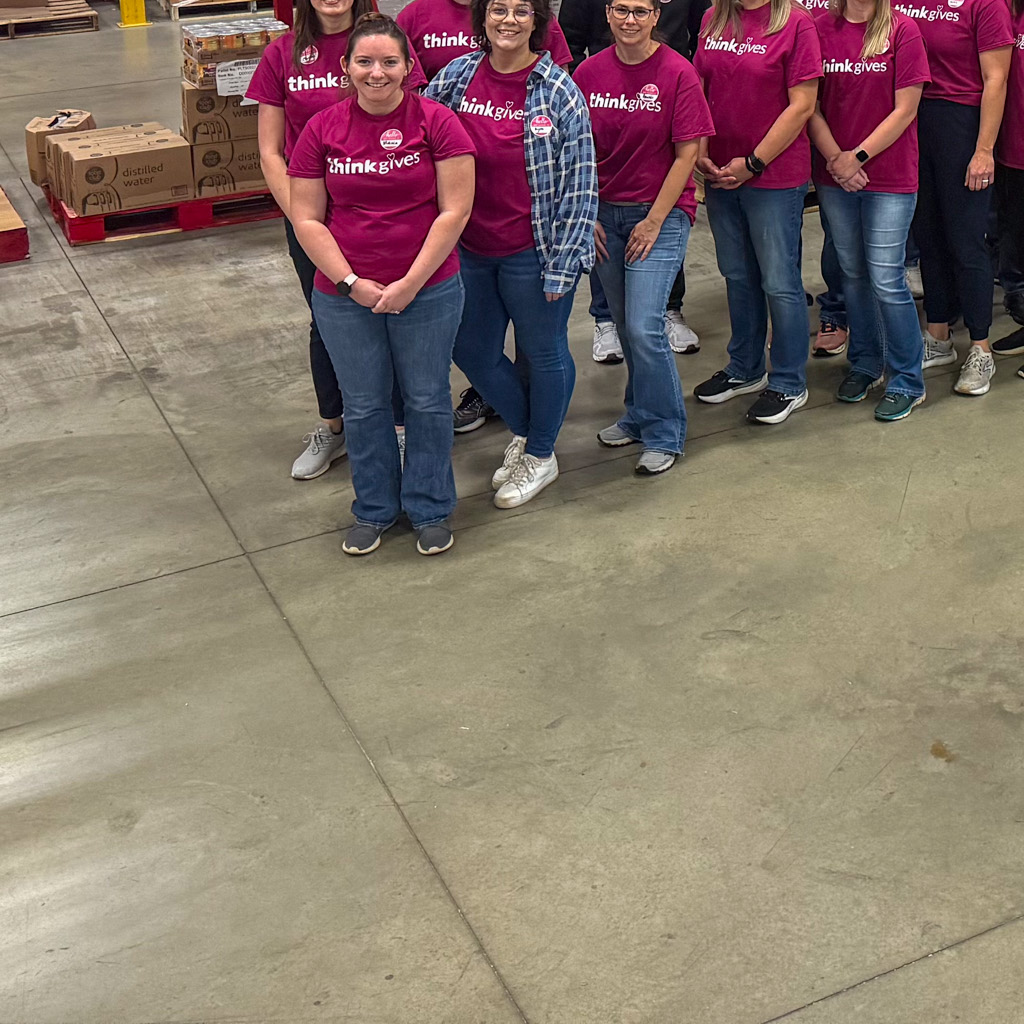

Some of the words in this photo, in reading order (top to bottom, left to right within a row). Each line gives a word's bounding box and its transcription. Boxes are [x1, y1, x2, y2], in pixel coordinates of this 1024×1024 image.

[423, 31, 481, 49] thinkg
[822, 57, 887, 75] hinkgives
[288, 72, 349, 92] thinkg
[233, 109, 259, 118] wate
[122, 163, 164, 178] distilled
[123, 175, 154, 188] water
